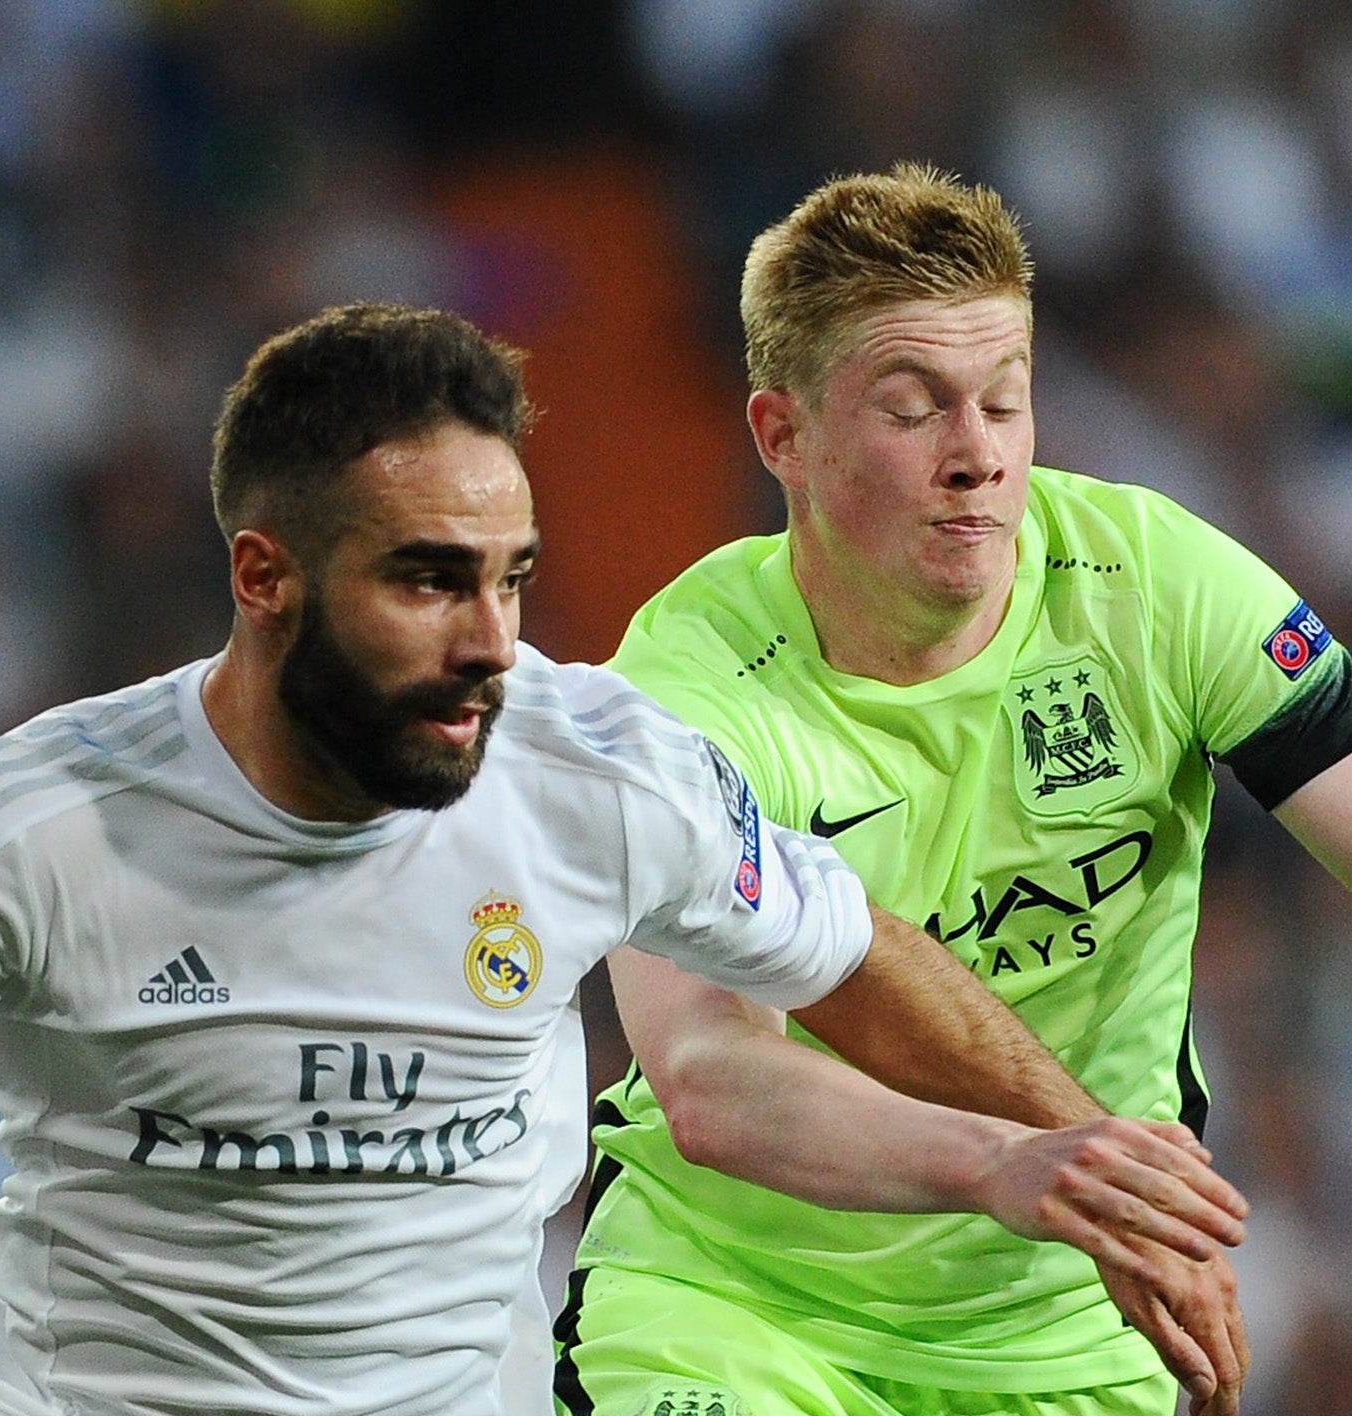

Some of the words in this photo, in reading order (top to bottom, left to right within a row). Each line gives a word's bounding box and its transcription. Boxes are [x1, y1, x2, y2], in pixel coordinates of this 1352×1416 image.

[924, 830, 1153, 943] HAD
[970, 922, 1097, 977] AYS
[137, 981, 231, 1005] adidas
[298, 1041, 424, 1113] Fly
[127, 1087, 532, 1176] Emirates
